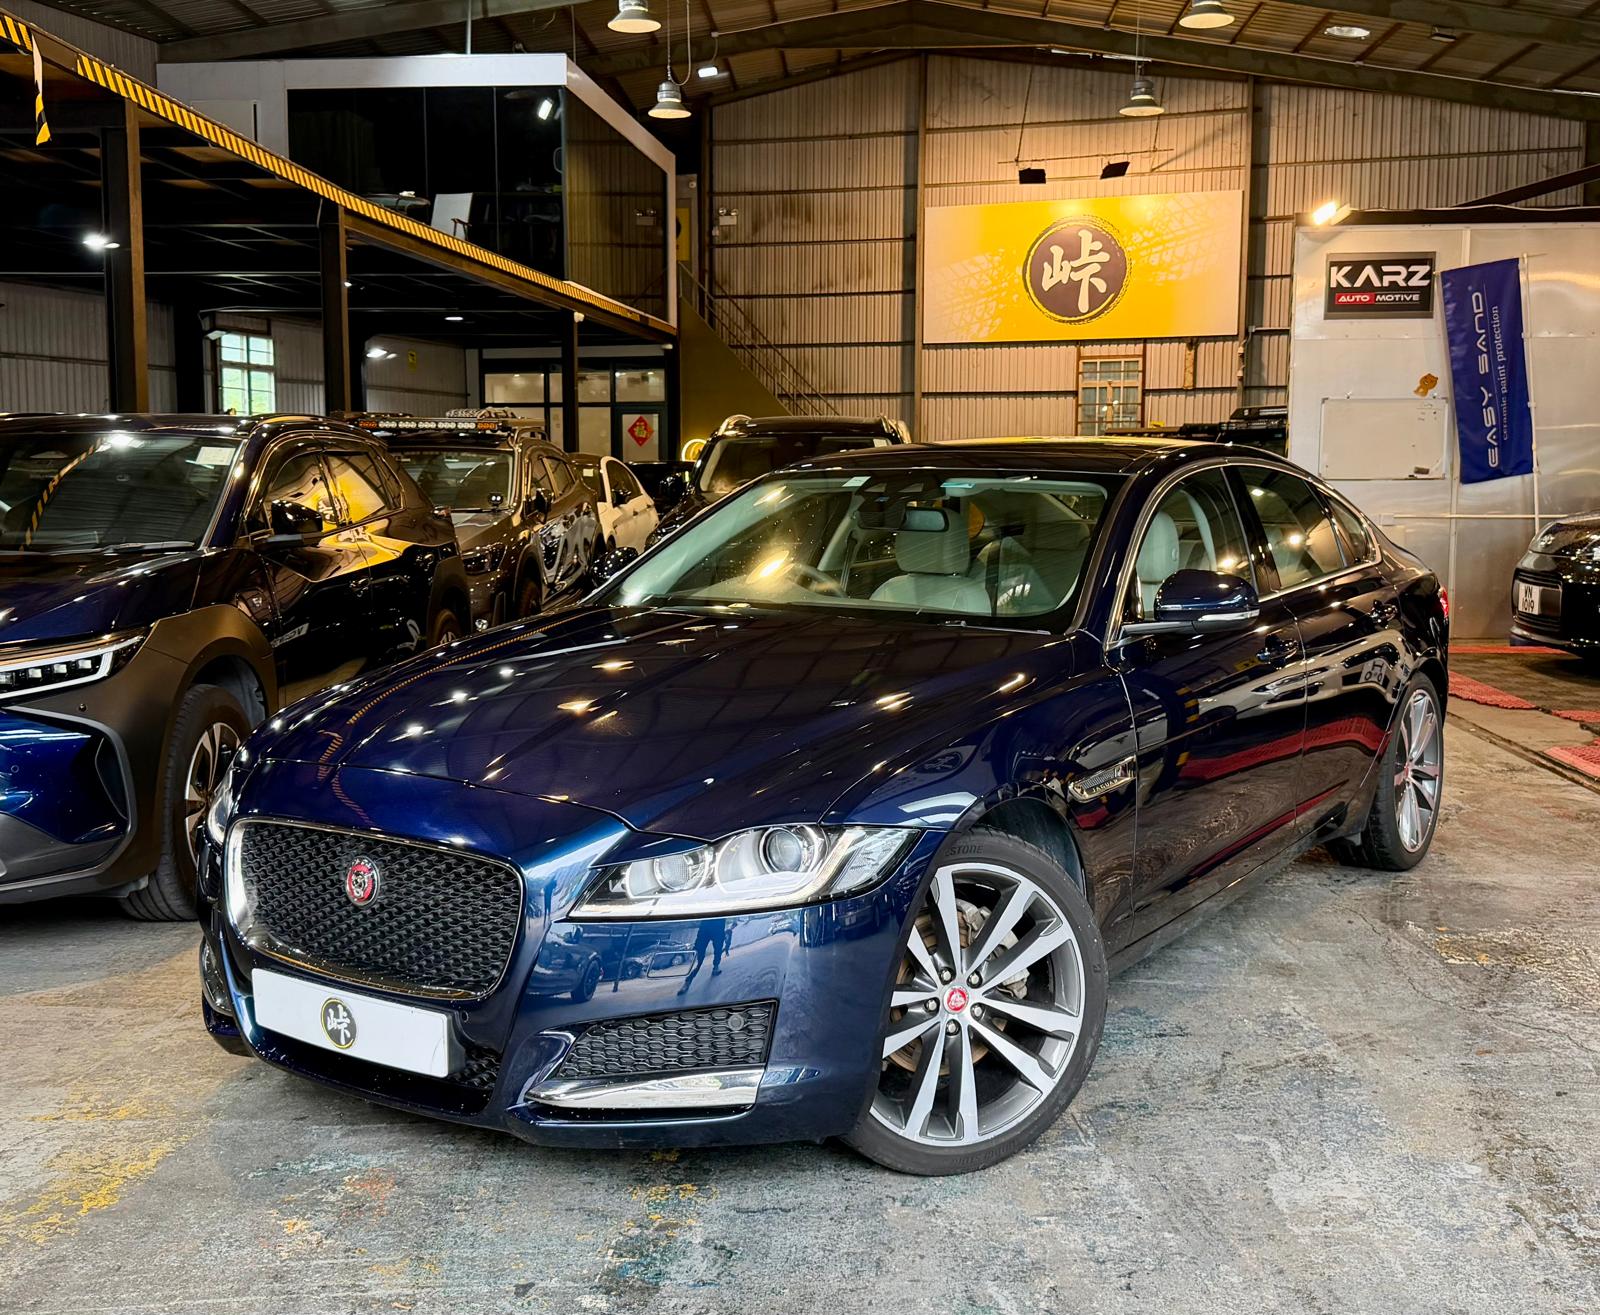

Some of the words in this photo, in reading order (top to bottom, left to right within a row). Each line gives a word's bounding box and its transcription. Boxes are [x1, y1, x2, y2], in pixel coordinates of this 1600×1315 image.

[1041, 229, 1110, 314] 峠
[1330, 265, 1431, 288] KARZ
[1338, 294, 1370, 303] AUTO
[1375, 293, 1420, 302] MOTIVE
[1471, 292, 1489, 375] SAND
[1491, 305, 1507, 362] protection
[1497, 365, 1508, 394] paint
[1480, 386, 1499, 468] EASY
[1092, 779, 1118, 793] JAGUAR
[326, 1004, 351, 1046] 峠
